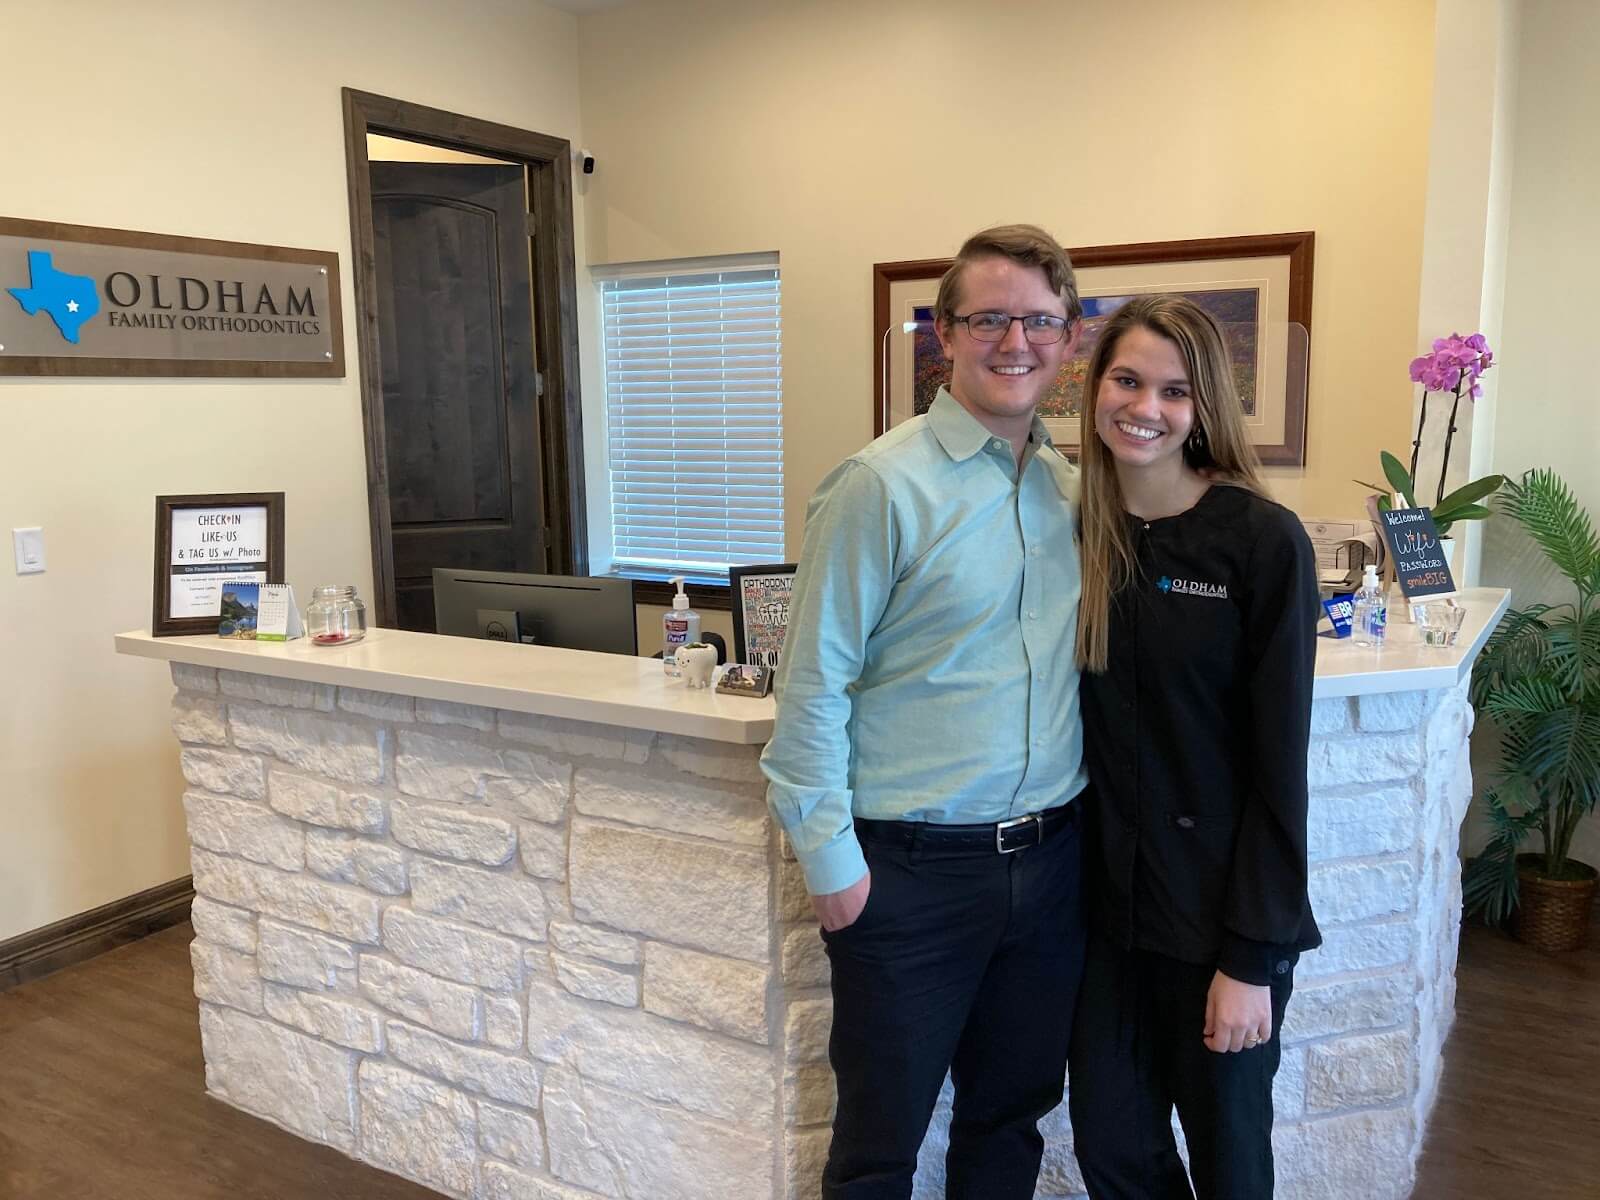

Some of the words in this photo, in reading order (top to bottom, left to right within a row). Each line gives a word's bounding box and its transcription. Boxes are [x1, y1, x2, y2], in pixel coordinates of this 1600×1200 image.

[105, 272, 317, 317] OLDHAM
[109, 311, 177, 329] FAMILY
[182, 315, 321, 336] ORTHODONTICS
[198, 514, 226, 526] CHECK
[232, 514, 241, 525] IN
[1386, 509, 1426, 526] Welcome!
[227, 531, 237, 542] US
[178, 549, 184, 559] &
[189, 549, 204, 558] TAG
[209, 548, 219, 558] US
[238, 547, 261, 557] Photo
[1172, 579, 1227, 593] OLDHAM
[749, 652, 766, 667] DR.
